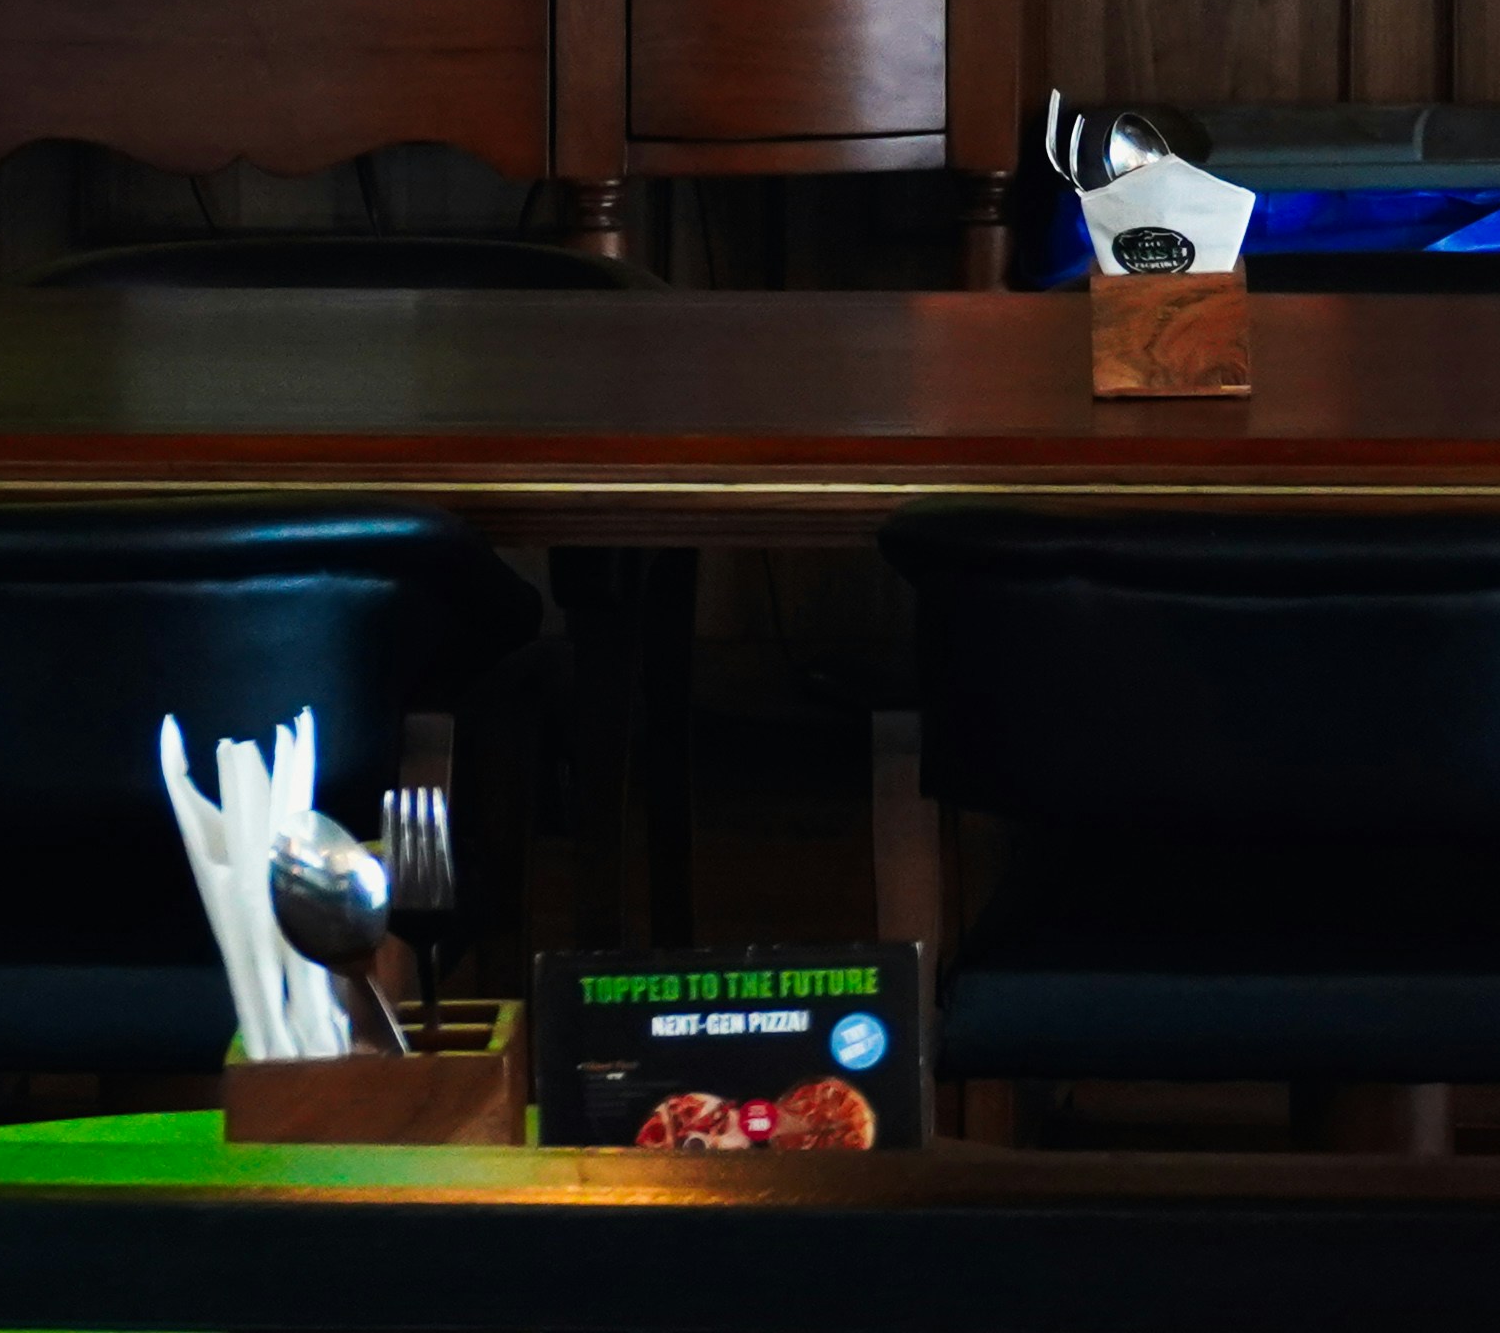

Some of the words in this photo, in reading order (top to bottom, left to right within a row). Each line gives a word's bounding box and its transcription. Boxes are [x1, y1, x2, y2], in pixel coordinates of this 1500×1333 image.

[580, 974, 680, 1004] TOPPED
[687, 971, 718, 1001] TO
[724, 970, 773, 999] THE
[780, 966, 879, 998] FUTURE
[651, 1012, 746, 1036] NEXT-GEN
